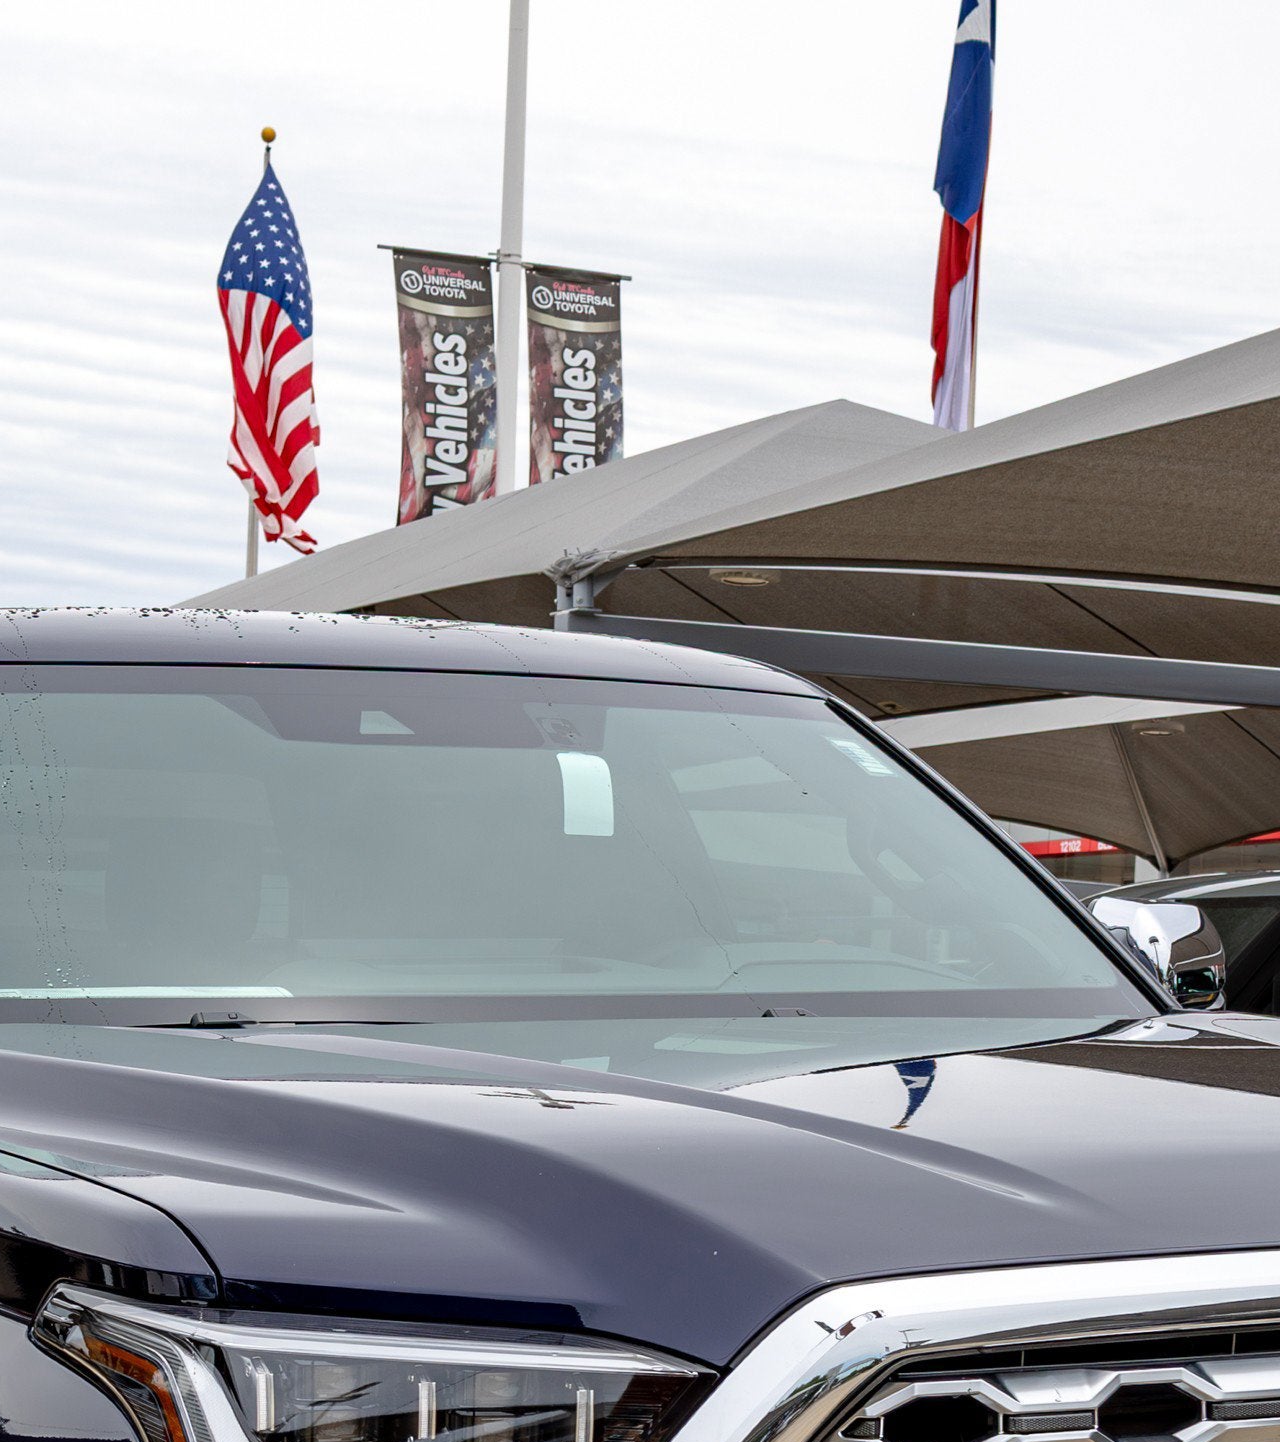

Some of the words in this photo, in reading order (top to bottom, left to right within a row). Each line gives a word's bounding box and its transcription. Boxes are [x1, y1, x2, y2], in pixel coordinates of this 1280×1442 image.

[423, 274, 486, 292] UNIVERSAL
[423, 284, 467, 300] TOYOTA
[554, 290, 615, 308] UNIVERSAL
[554, 301, 597, 316] TOYOTA
[425, 332, 468, 486] Vehicles
[554, 348, 597, 479] ehicles
